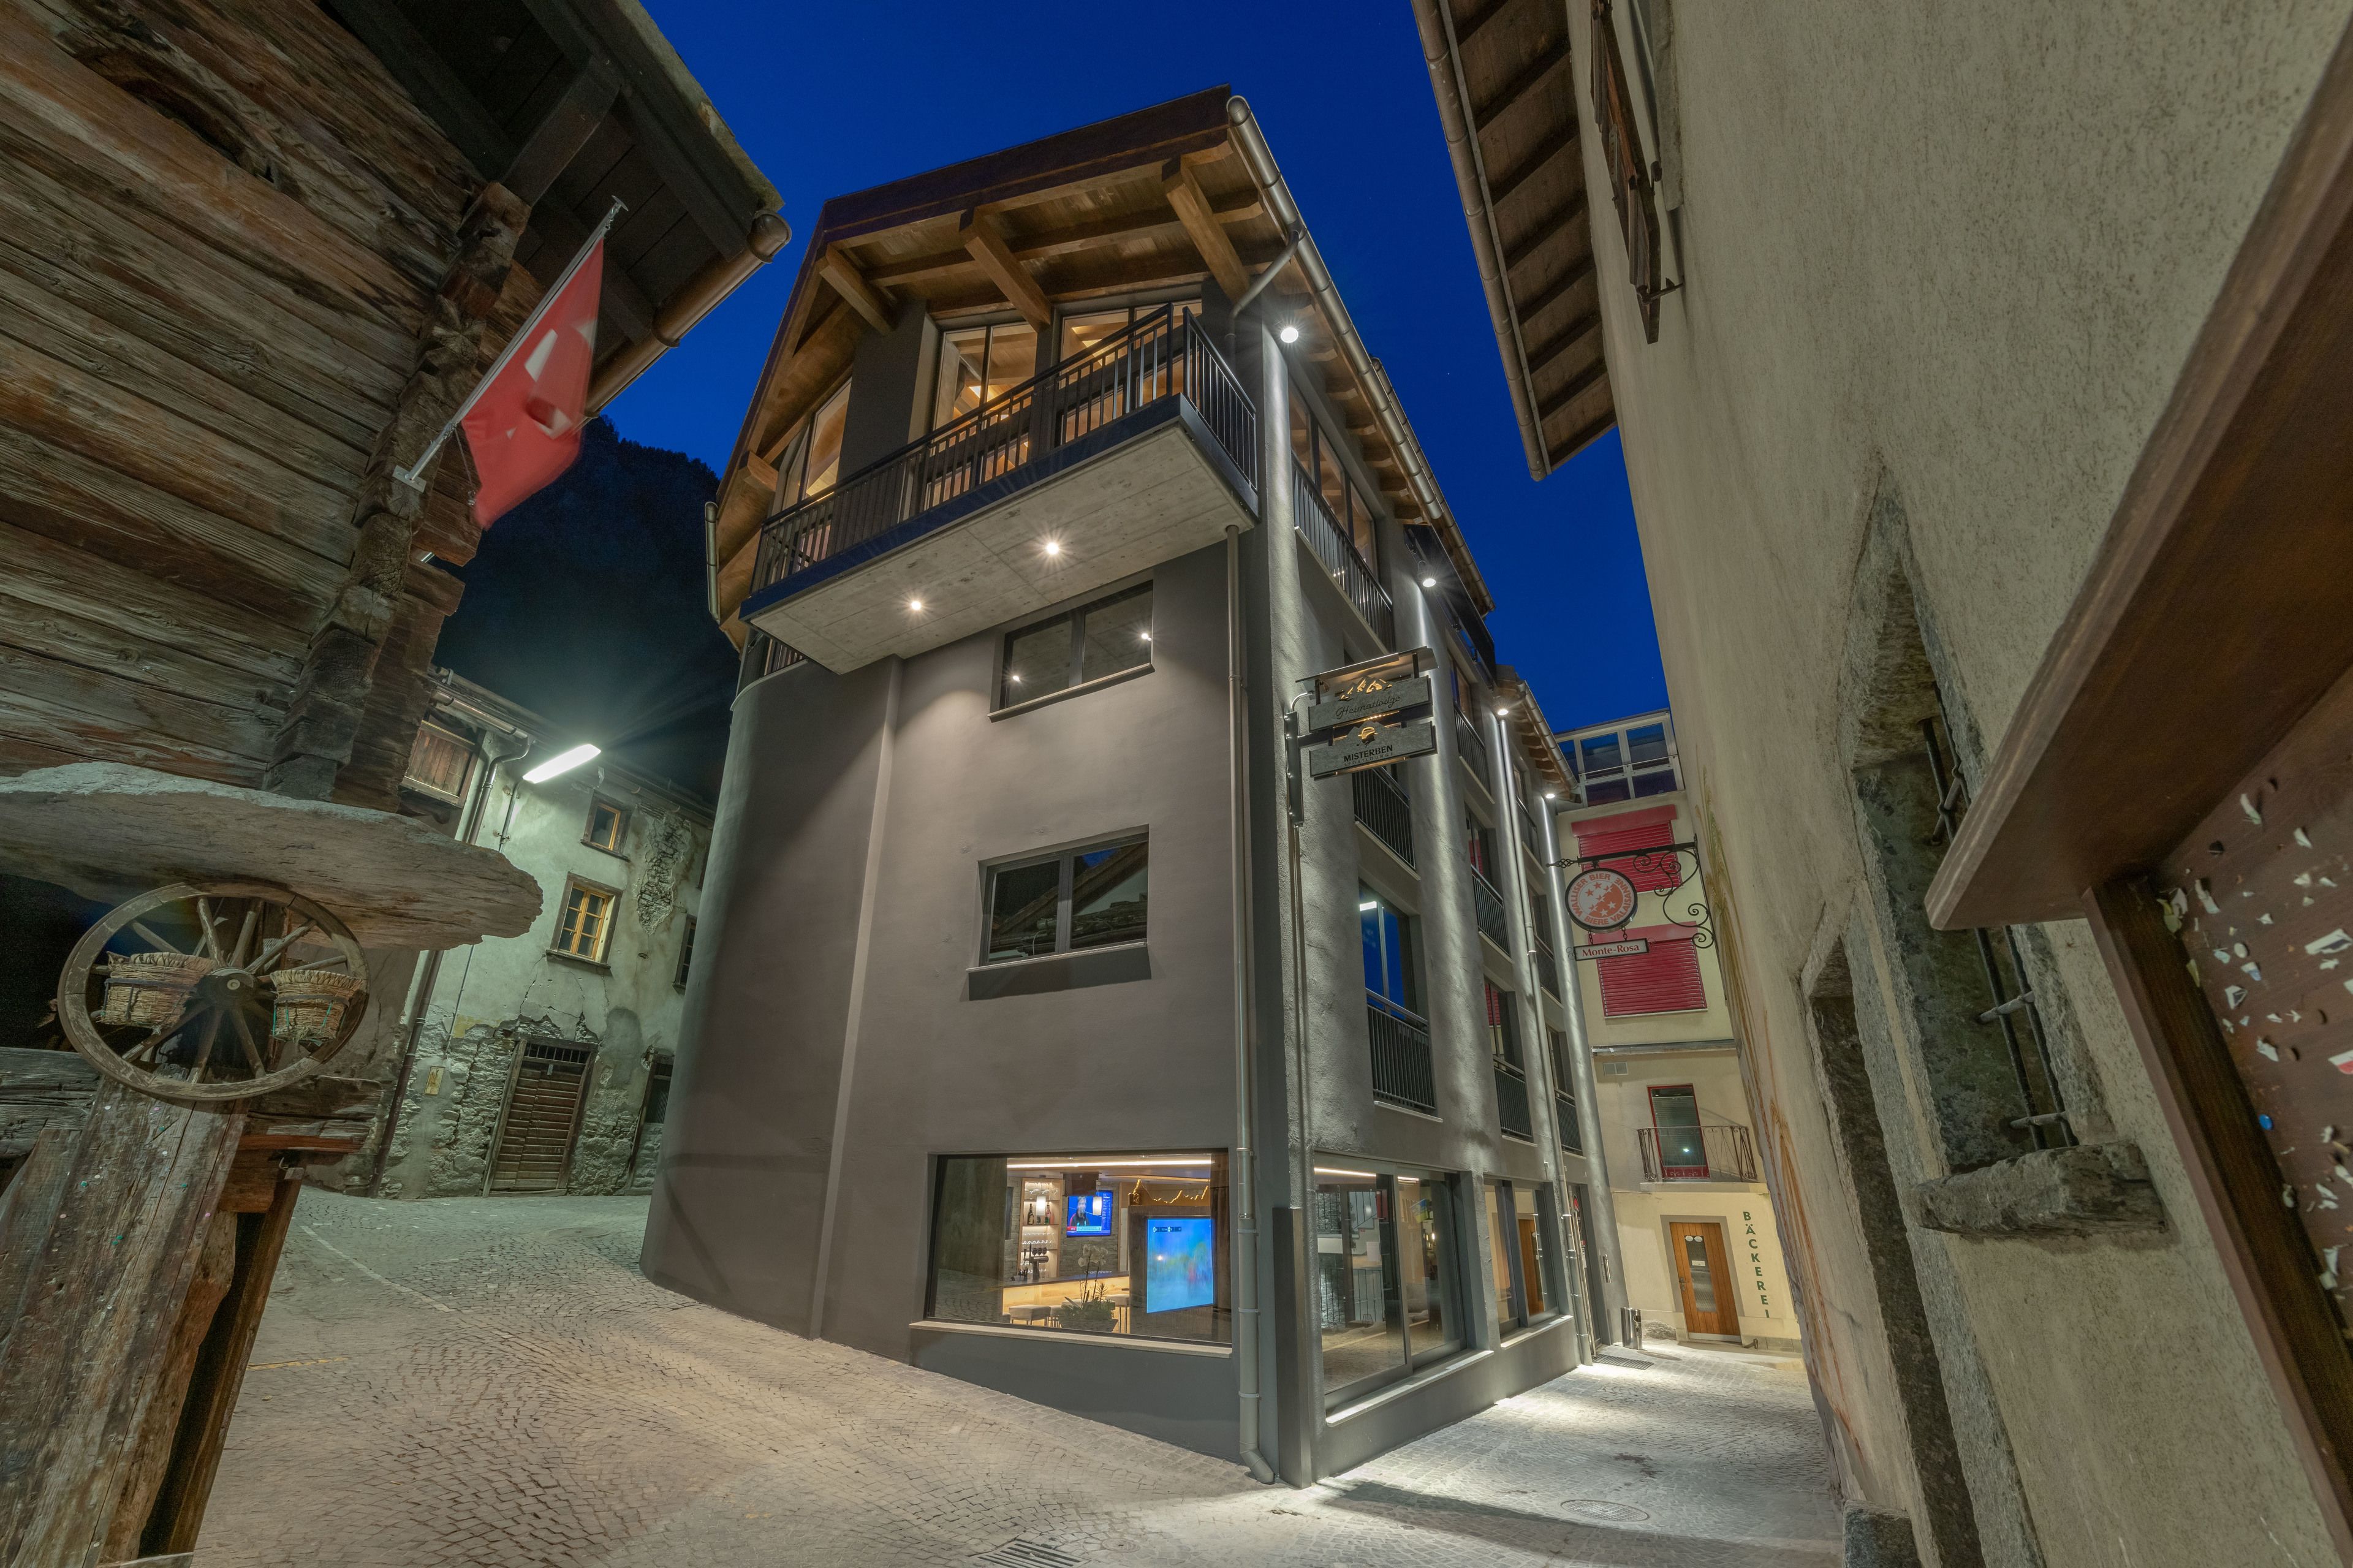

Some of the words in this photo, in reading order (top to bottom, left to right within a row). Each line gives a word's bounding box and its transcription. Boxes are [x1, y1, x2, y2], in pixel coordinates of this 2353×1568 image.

[1336, 695, 1401, 720] Heimatlodge
[1344, 744, 1393, 762] MISTERBEN
[1571, 877, 1589, 917] WALLISER
[1589, 873, 1612, 881] BIER
[1584, 915, 1609, 925] BIERE
[1610, 877, 1632, 922] VALAISANNE
[1582, 944, 1640, 957] Monte-Rosa
[1743, 1211, 1770, 1318] BÄCKEREI
